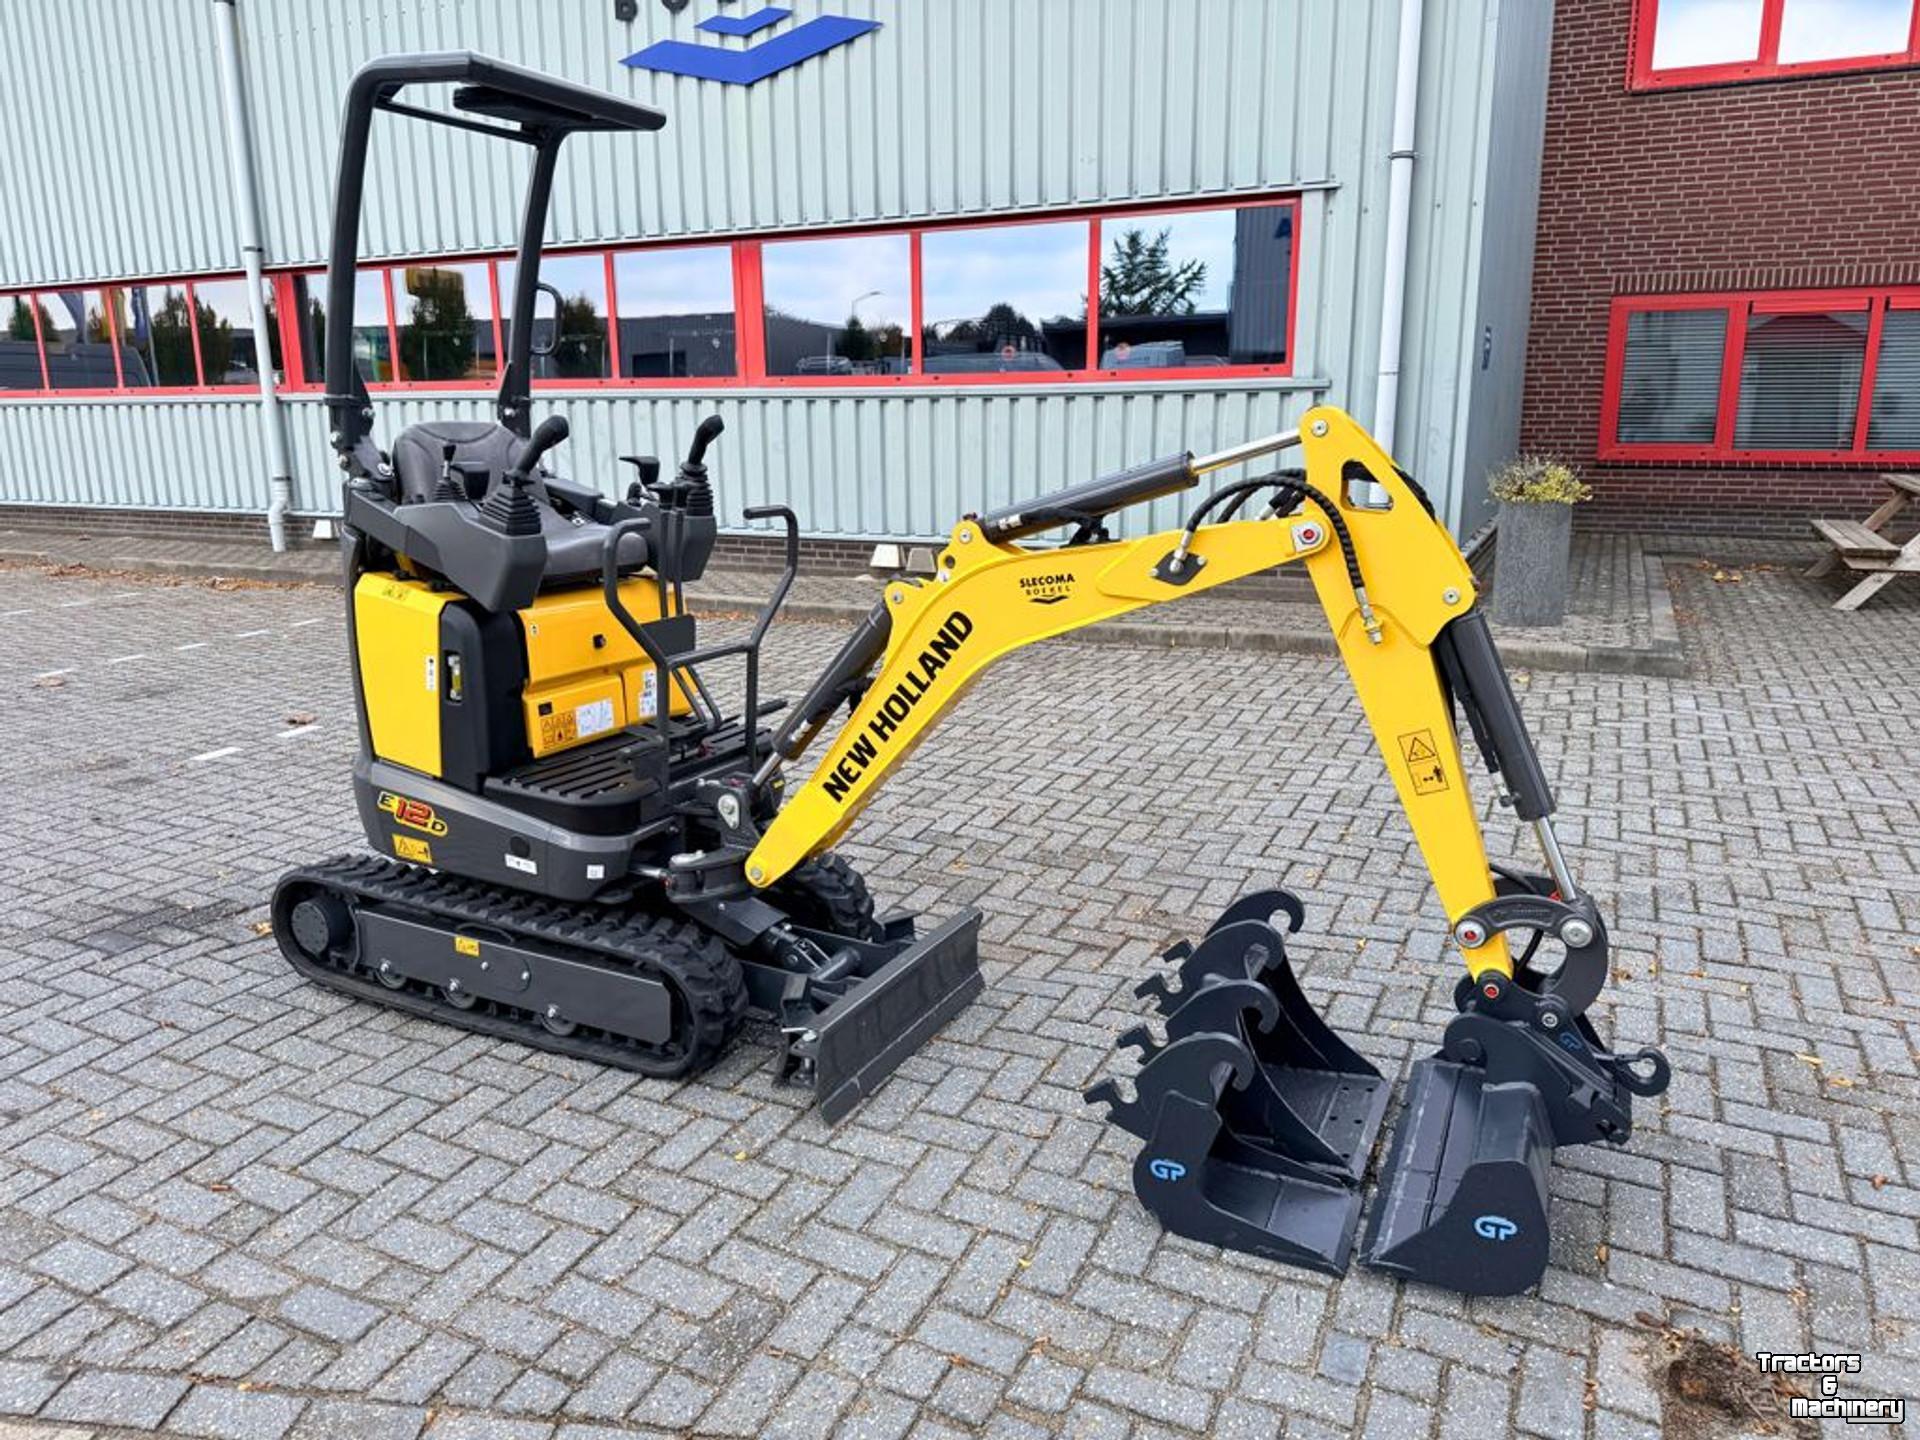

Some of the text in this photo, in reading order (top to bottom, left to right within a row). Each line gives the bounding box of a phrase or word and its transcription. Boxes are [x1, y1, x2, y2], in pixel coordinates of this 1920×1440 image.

[1019, 573, 1075, 588] SLECOMA
[822, 611, 974, 804] NEW HOLLAND
[1150, 1159, 1186, 1181] GP
[1474, 1215, 1518, 1241] GP
